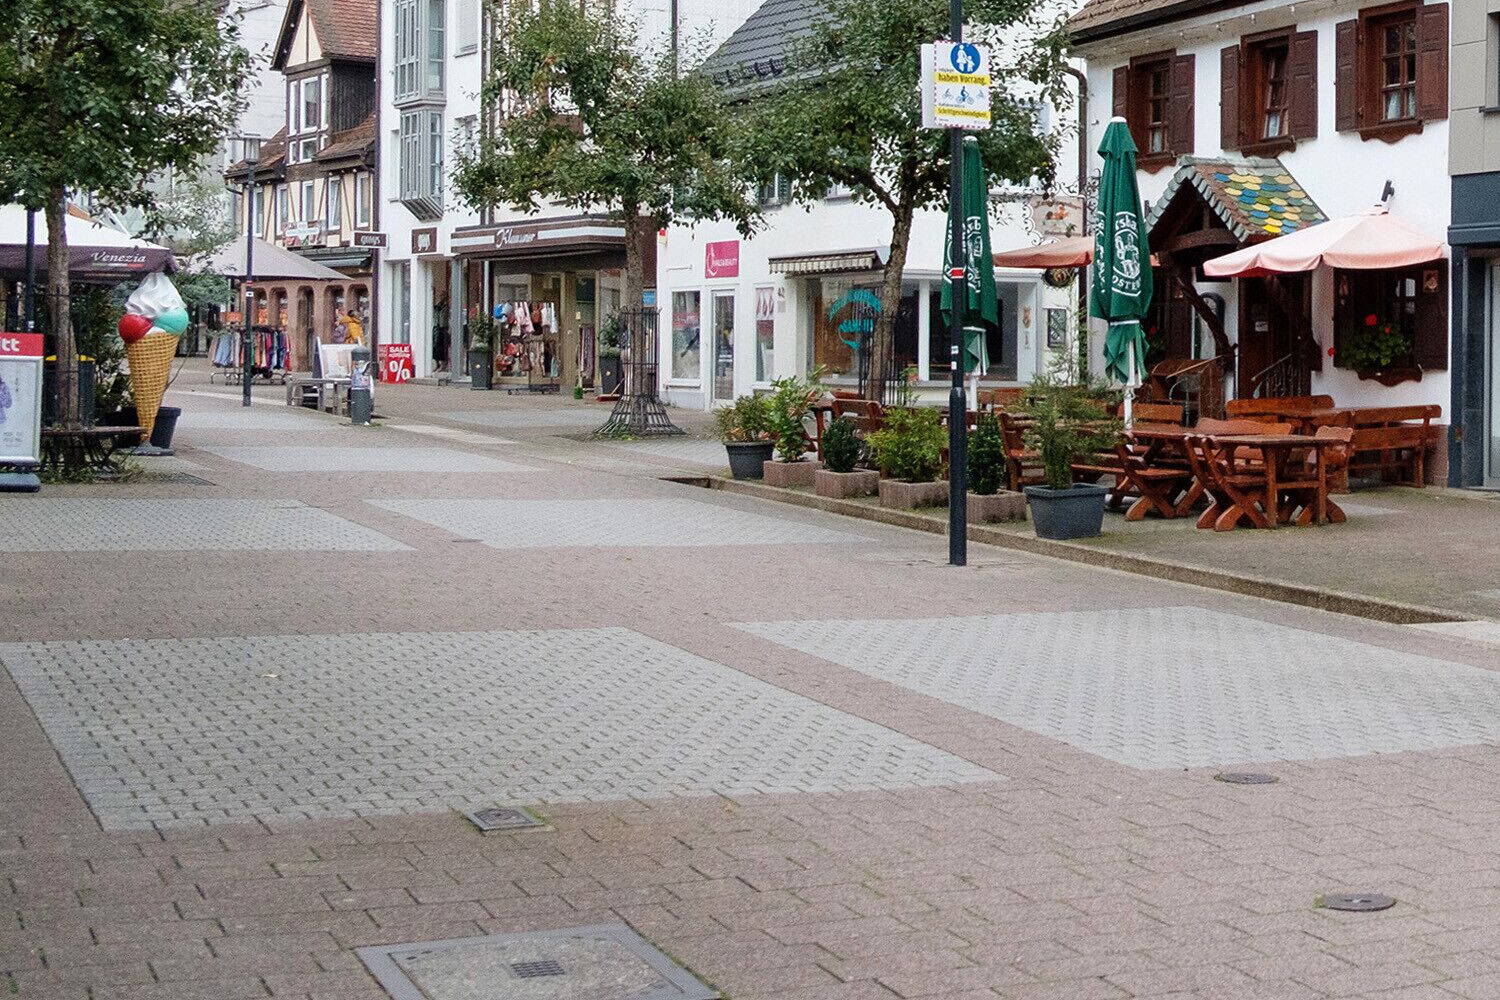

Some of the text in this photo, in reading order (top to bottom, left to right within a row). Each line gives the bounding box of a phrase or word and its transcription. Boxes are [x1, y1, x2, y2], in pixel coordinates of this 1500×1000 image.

[938, 73, 986, 86] haben Vorrang.
[91, 251, 147, 263] Venezia
[389, 359, 410, 382] %
